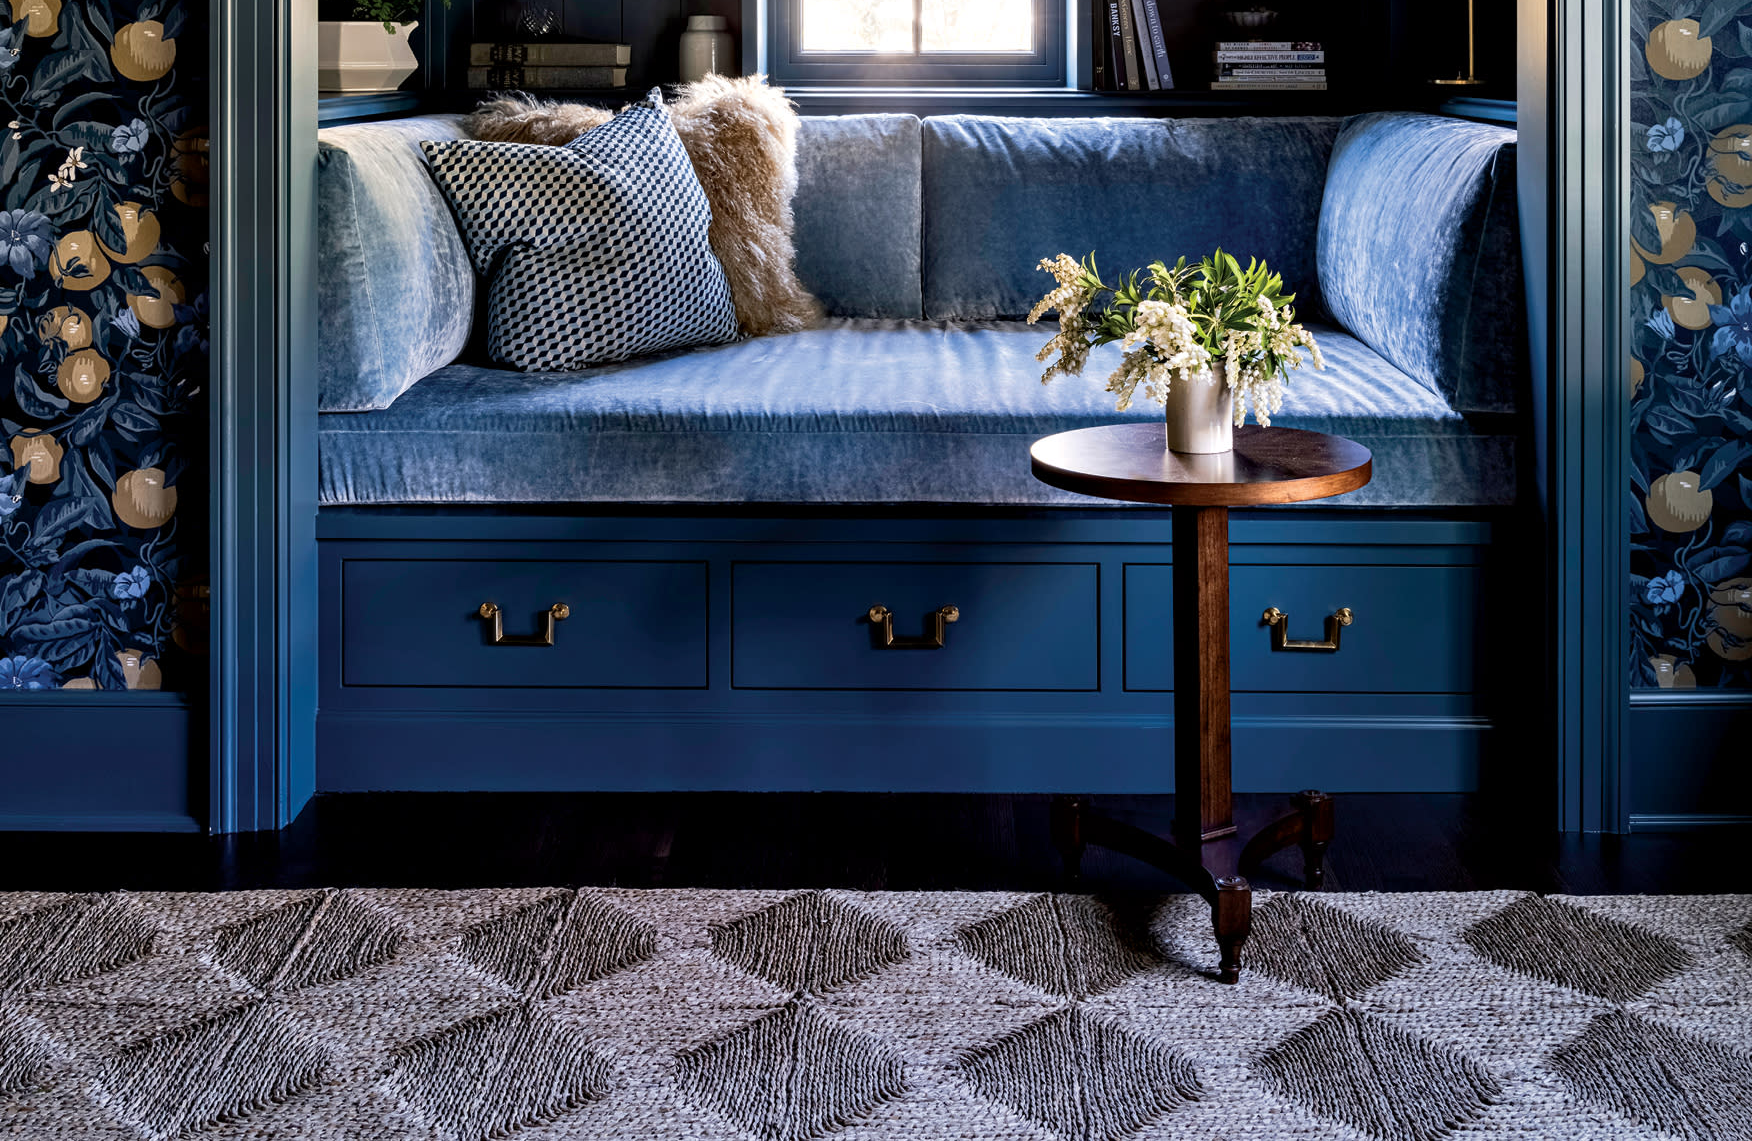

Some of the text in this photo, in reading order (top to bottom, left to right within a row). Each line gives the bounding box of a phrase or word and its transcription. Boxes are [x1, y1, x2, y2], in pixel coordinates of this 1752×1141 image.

[1109, 2, 1121, 37] BANKSY
[1146, 0, 1156, 25] down
[1153, 35, 1166, 58] earth
